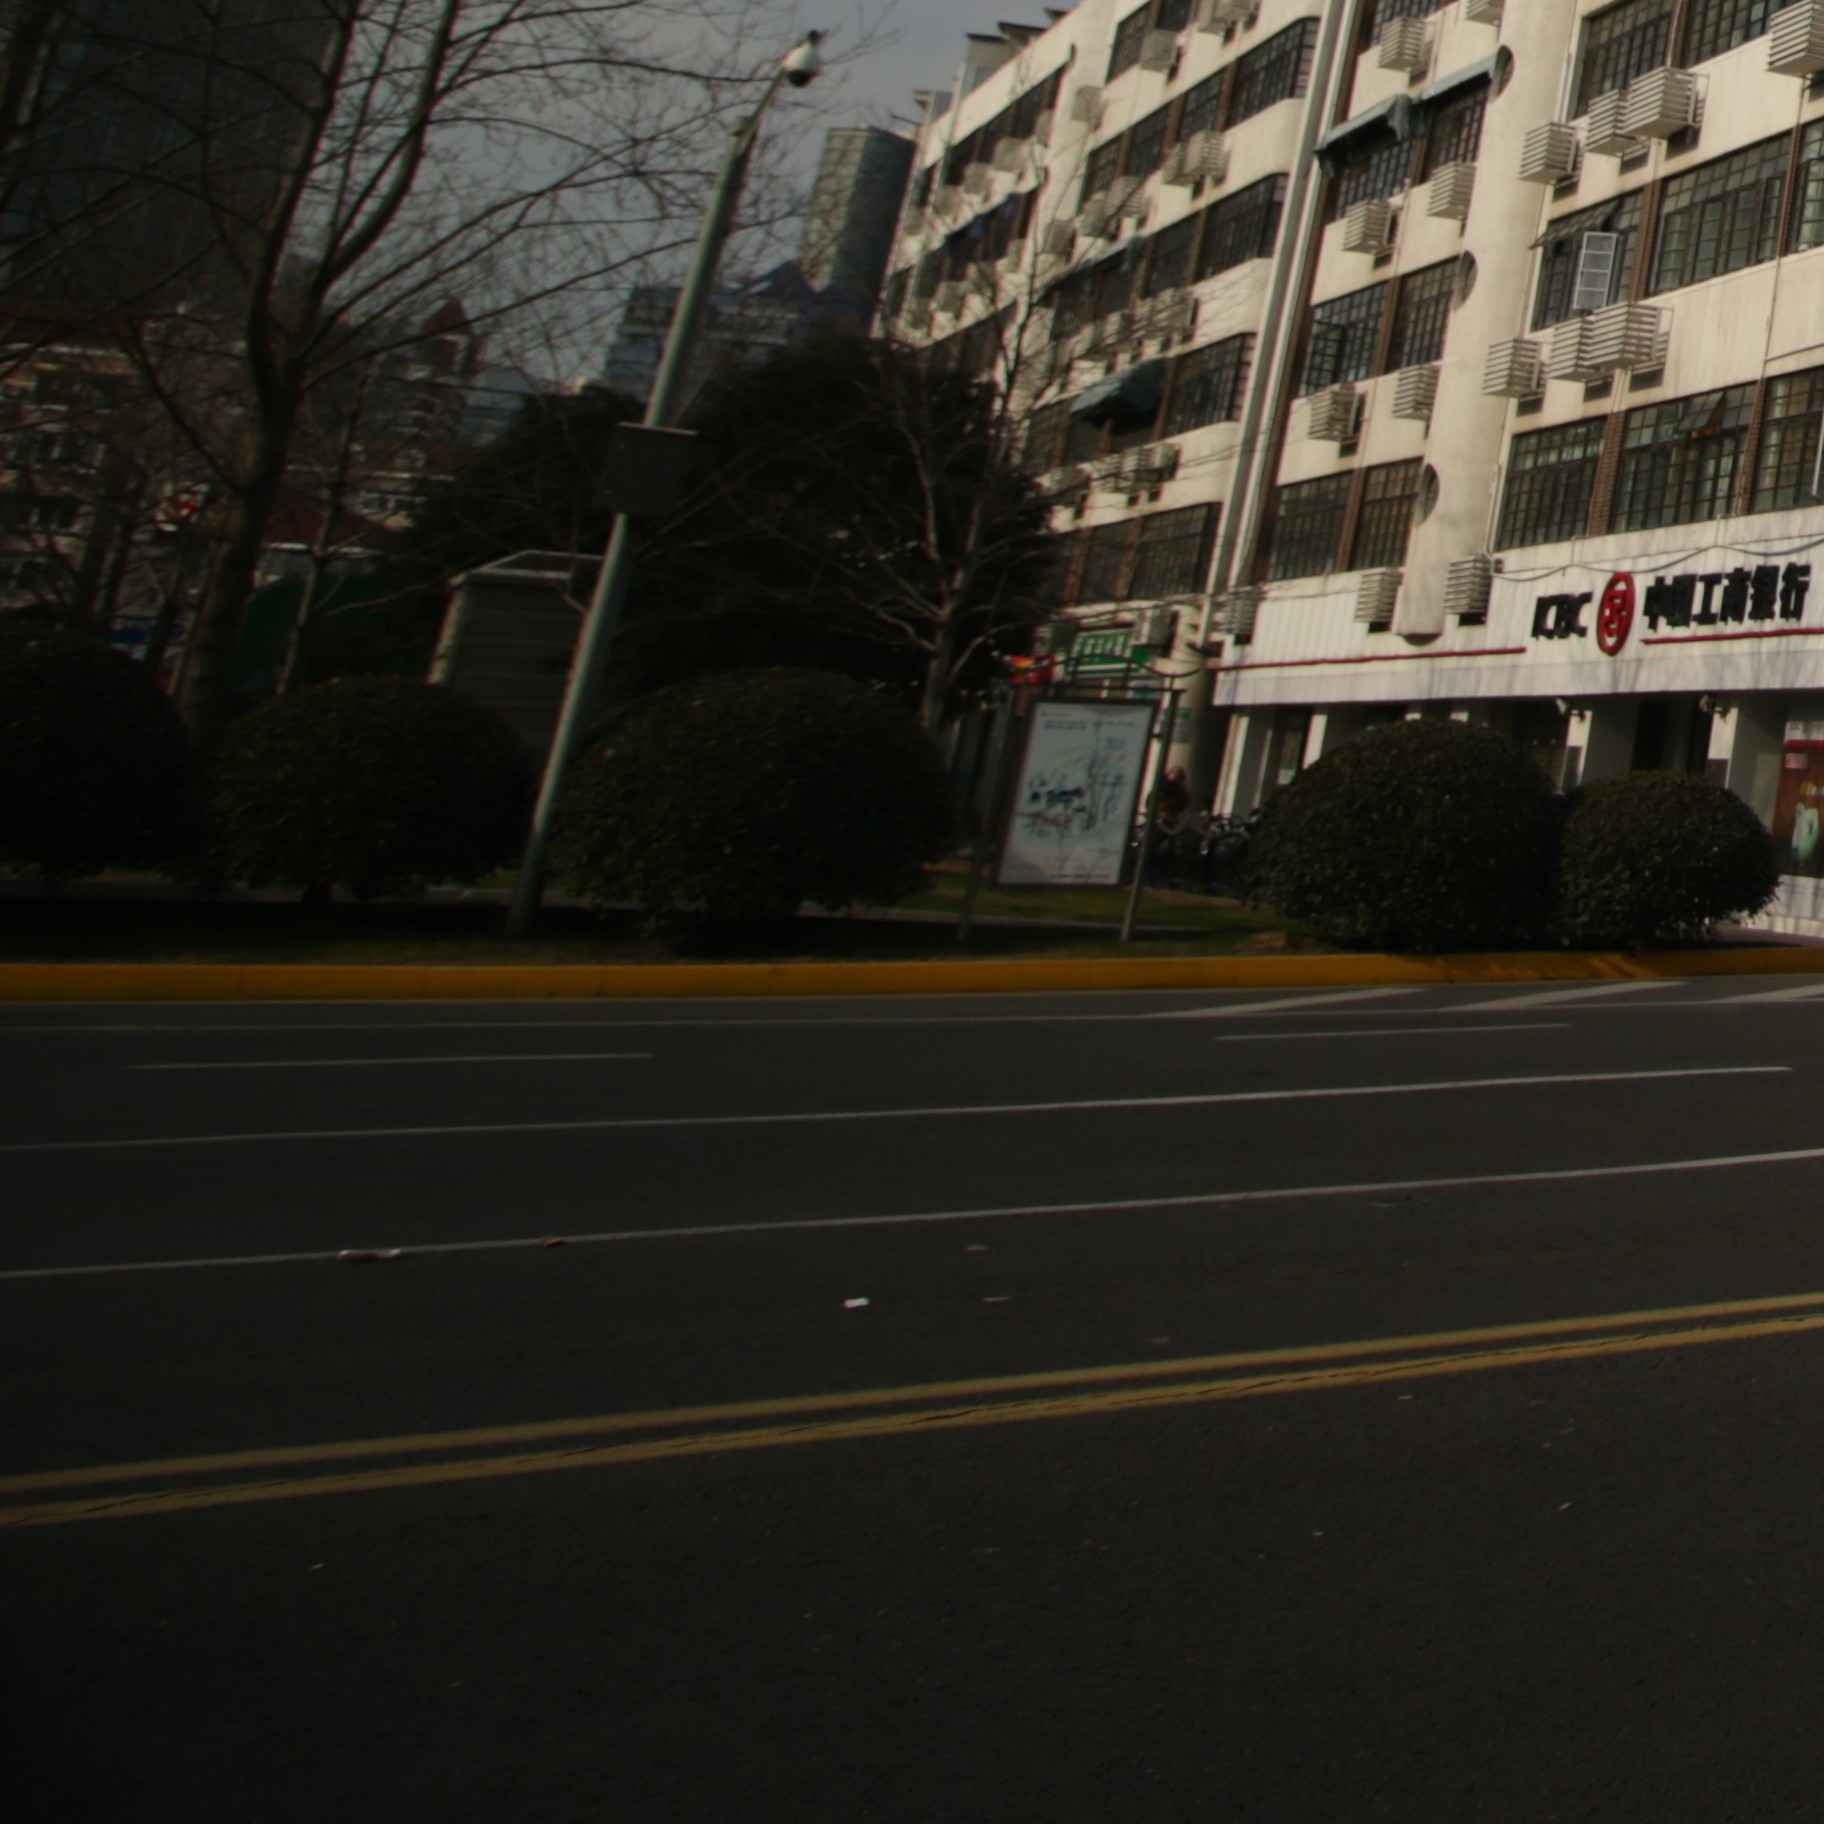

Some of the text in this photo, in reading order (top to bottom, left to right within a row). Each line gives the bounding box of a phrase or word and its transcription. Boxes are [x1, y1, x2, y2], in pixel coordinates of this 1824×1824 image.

[1531, 562, 1811, 640] ICBC 中国工商银行
